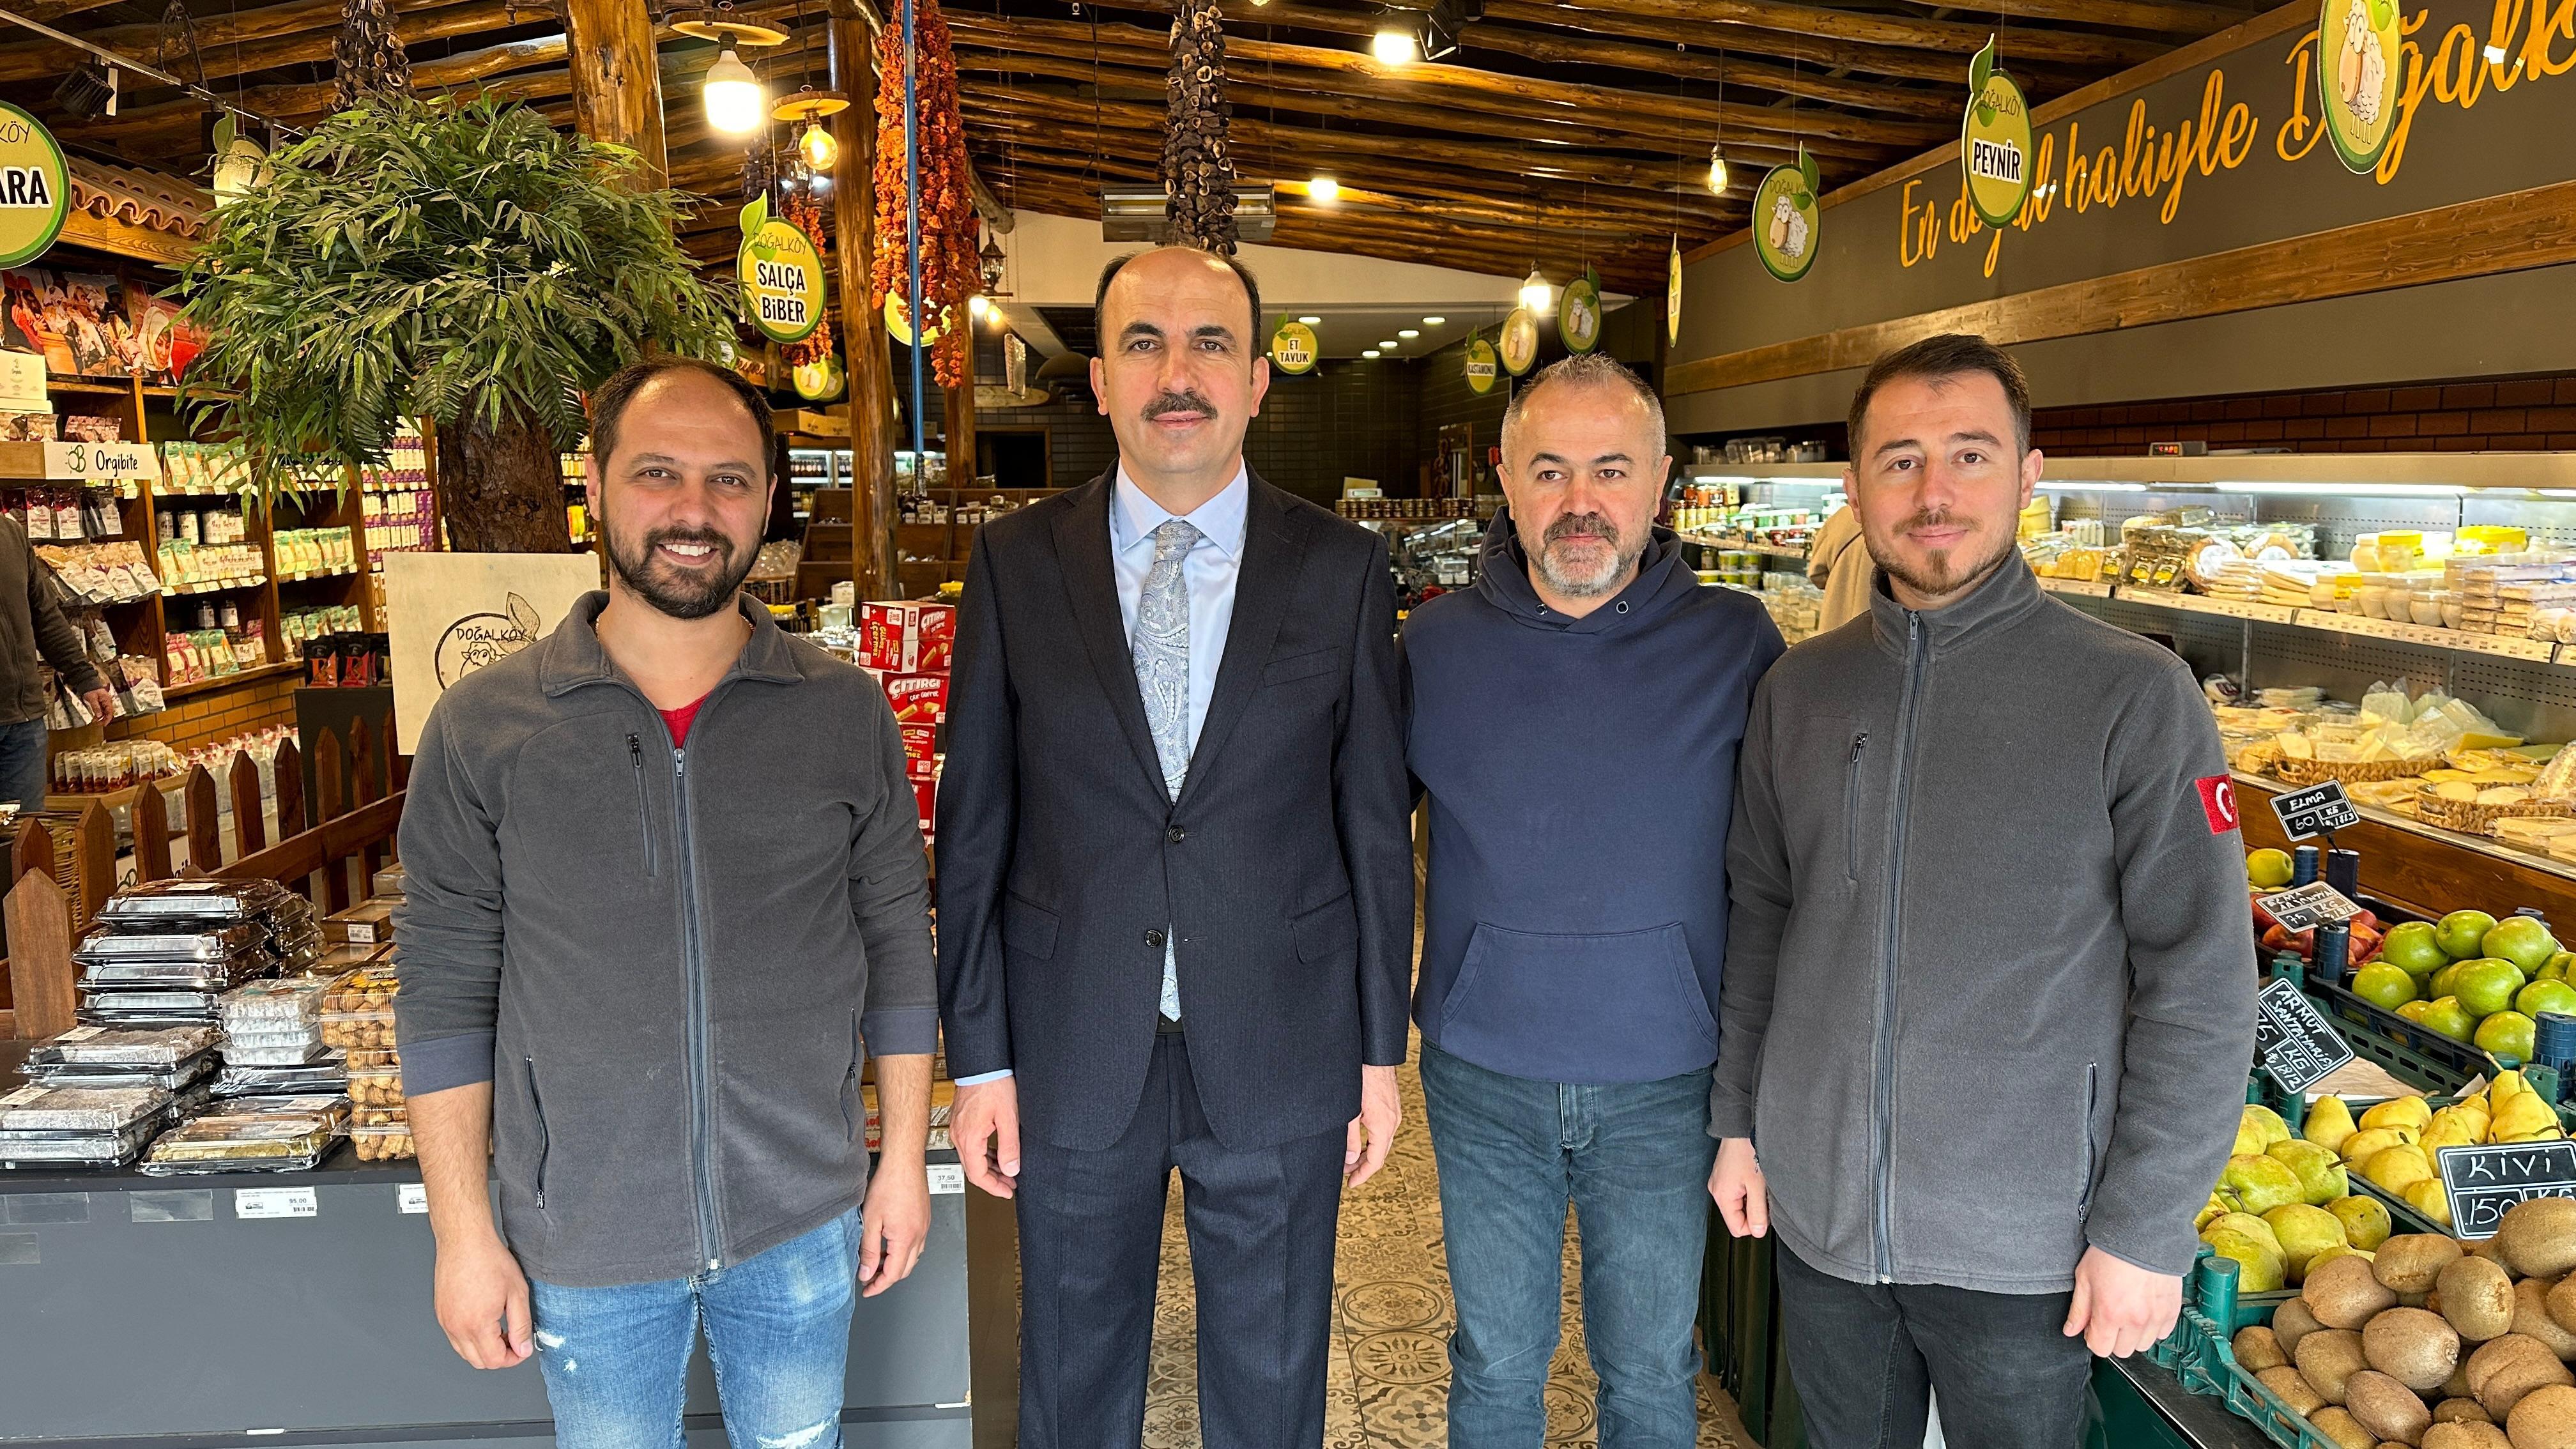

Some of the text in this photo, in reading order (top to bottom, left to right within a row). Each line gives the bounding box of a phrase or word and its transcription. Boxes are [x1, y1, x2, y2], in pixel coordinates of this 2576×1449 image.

[1901, 180, 1941, 267] En
[2064, 68, 2259, 225] haliyle
[1973, 141, 2020, 181] PEYNİR
[753, 232, 808, 255] DOĞALKÖY
[758, 263, 805, 296] SALÇA
[1289, 339, 1299, 350] ET
[1280, 352, 1308, 363] TAVUK
[96, 450, 137, 477] Orgibite
[456, 626, 525, 641] DOĞALKÖY
[887, 678, 940, 700] ÇITIRGI
[2289, 792, 2326, 811] ELMA
[2296, 816, 2315, 831] 60
[2276, 990, 2327, 1035] ARMUT
[2284, 1048, 2311, 1070] KG
